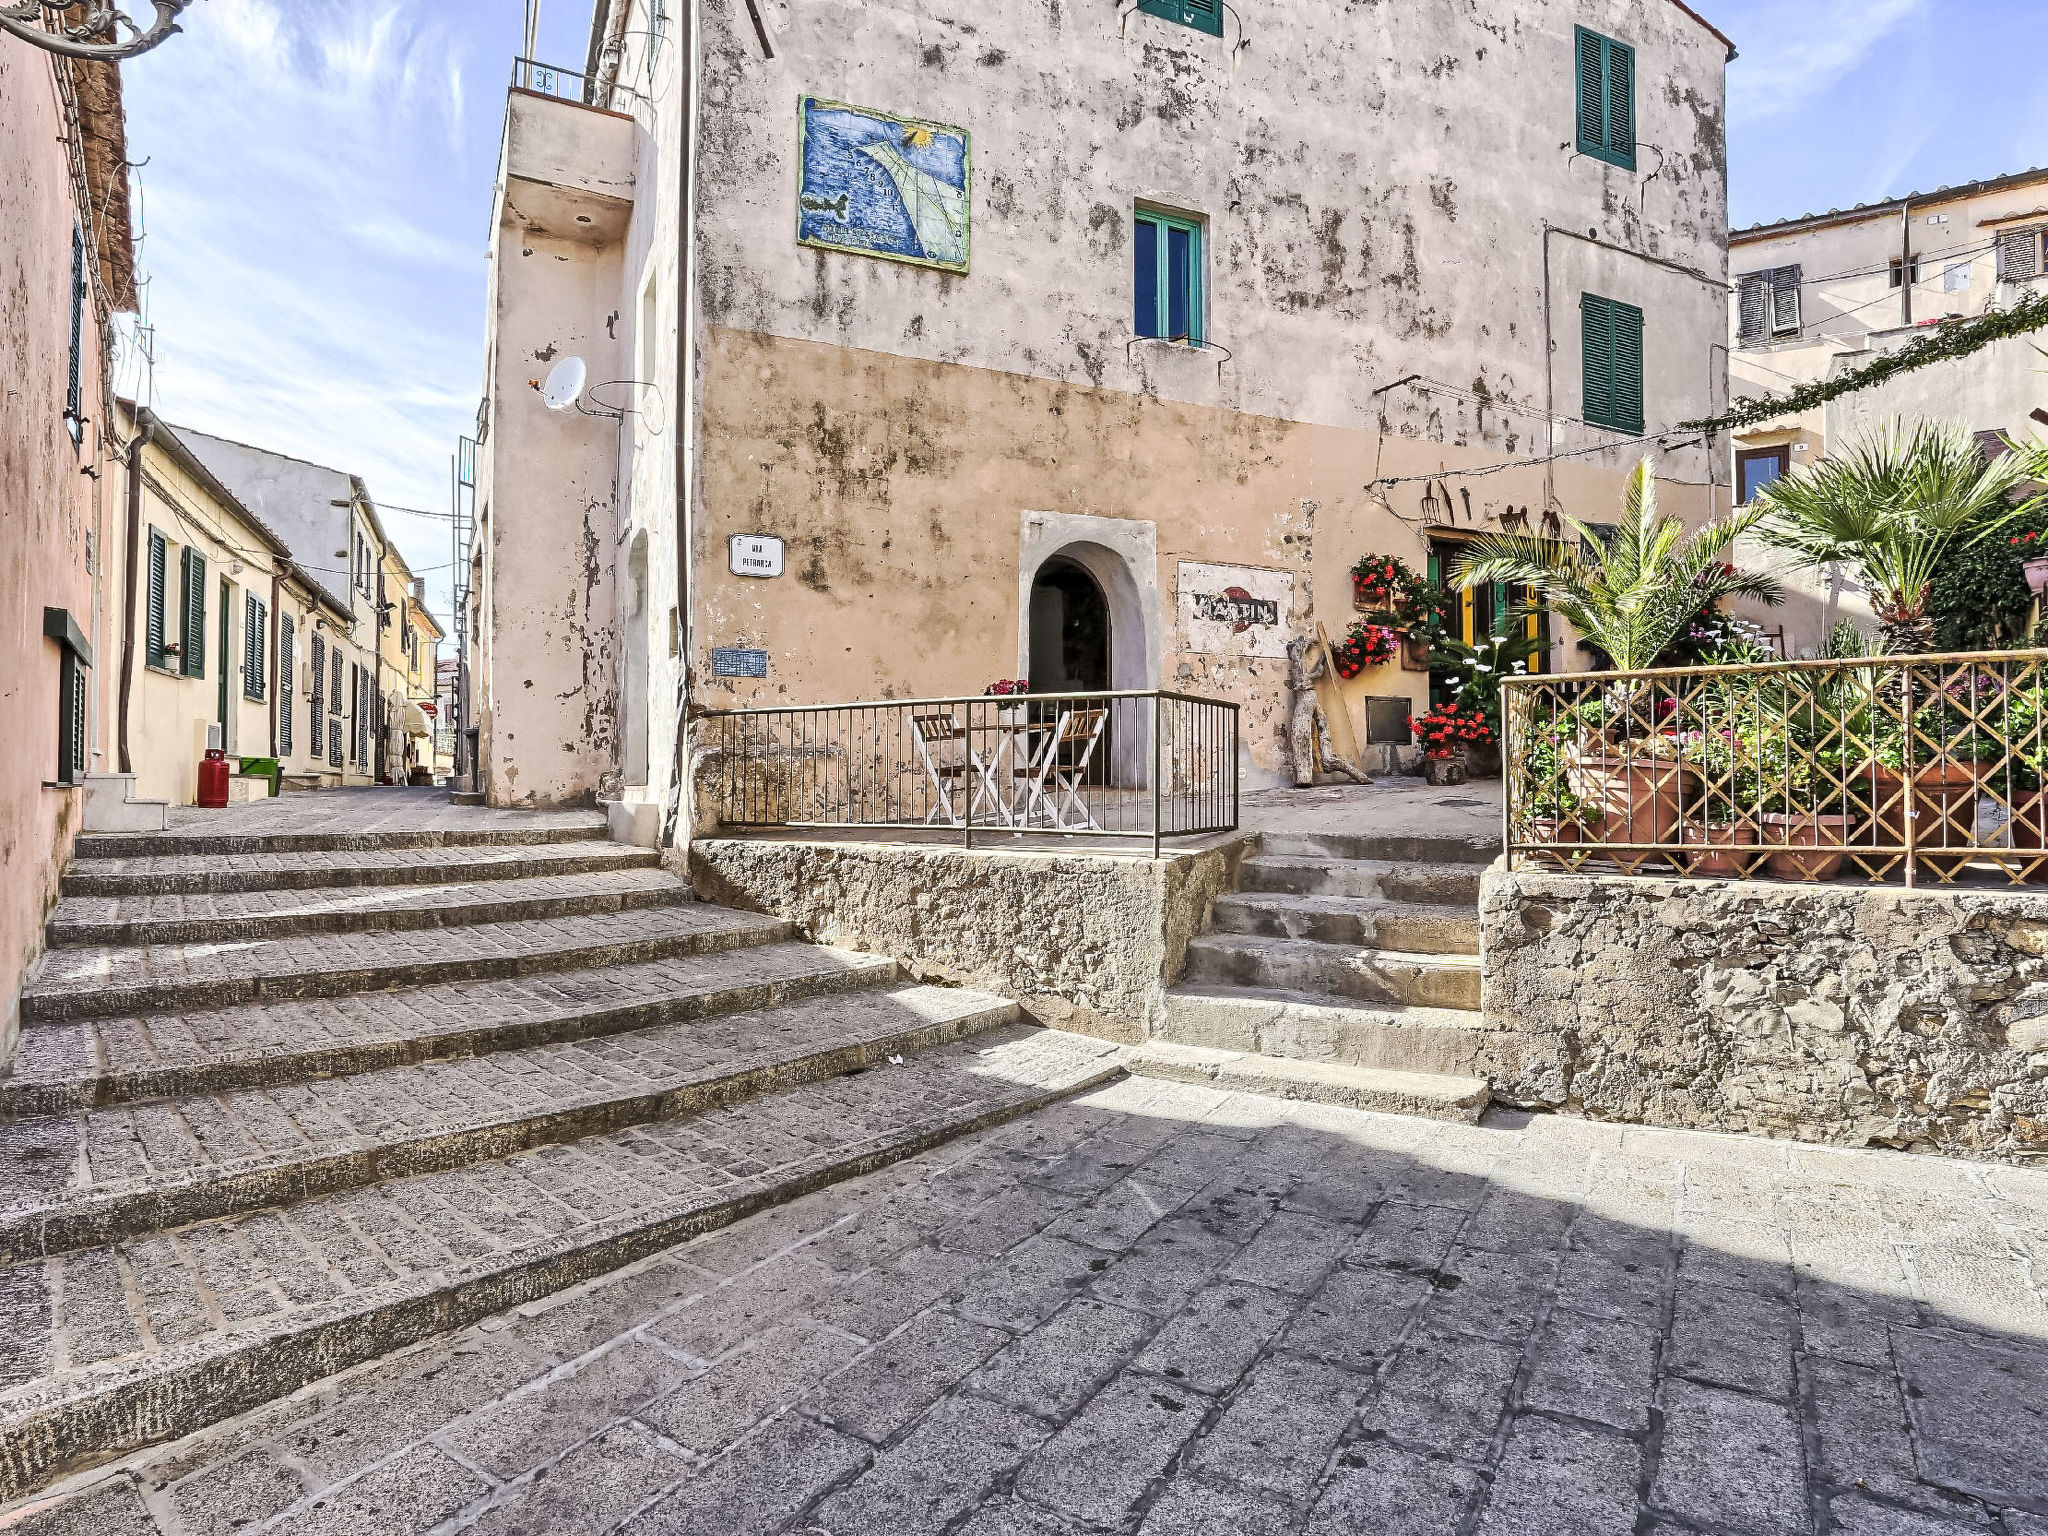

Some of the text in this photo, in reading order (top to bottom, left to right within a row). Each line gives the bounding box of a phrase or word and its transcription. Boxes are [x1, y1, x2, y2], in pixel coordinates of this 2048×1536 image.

[856, 159, 862, 167] 6
[870, 173, 876, 181] 8
[883, 188, 893, 196] 10
[752, 545, 762, 553] VIA
